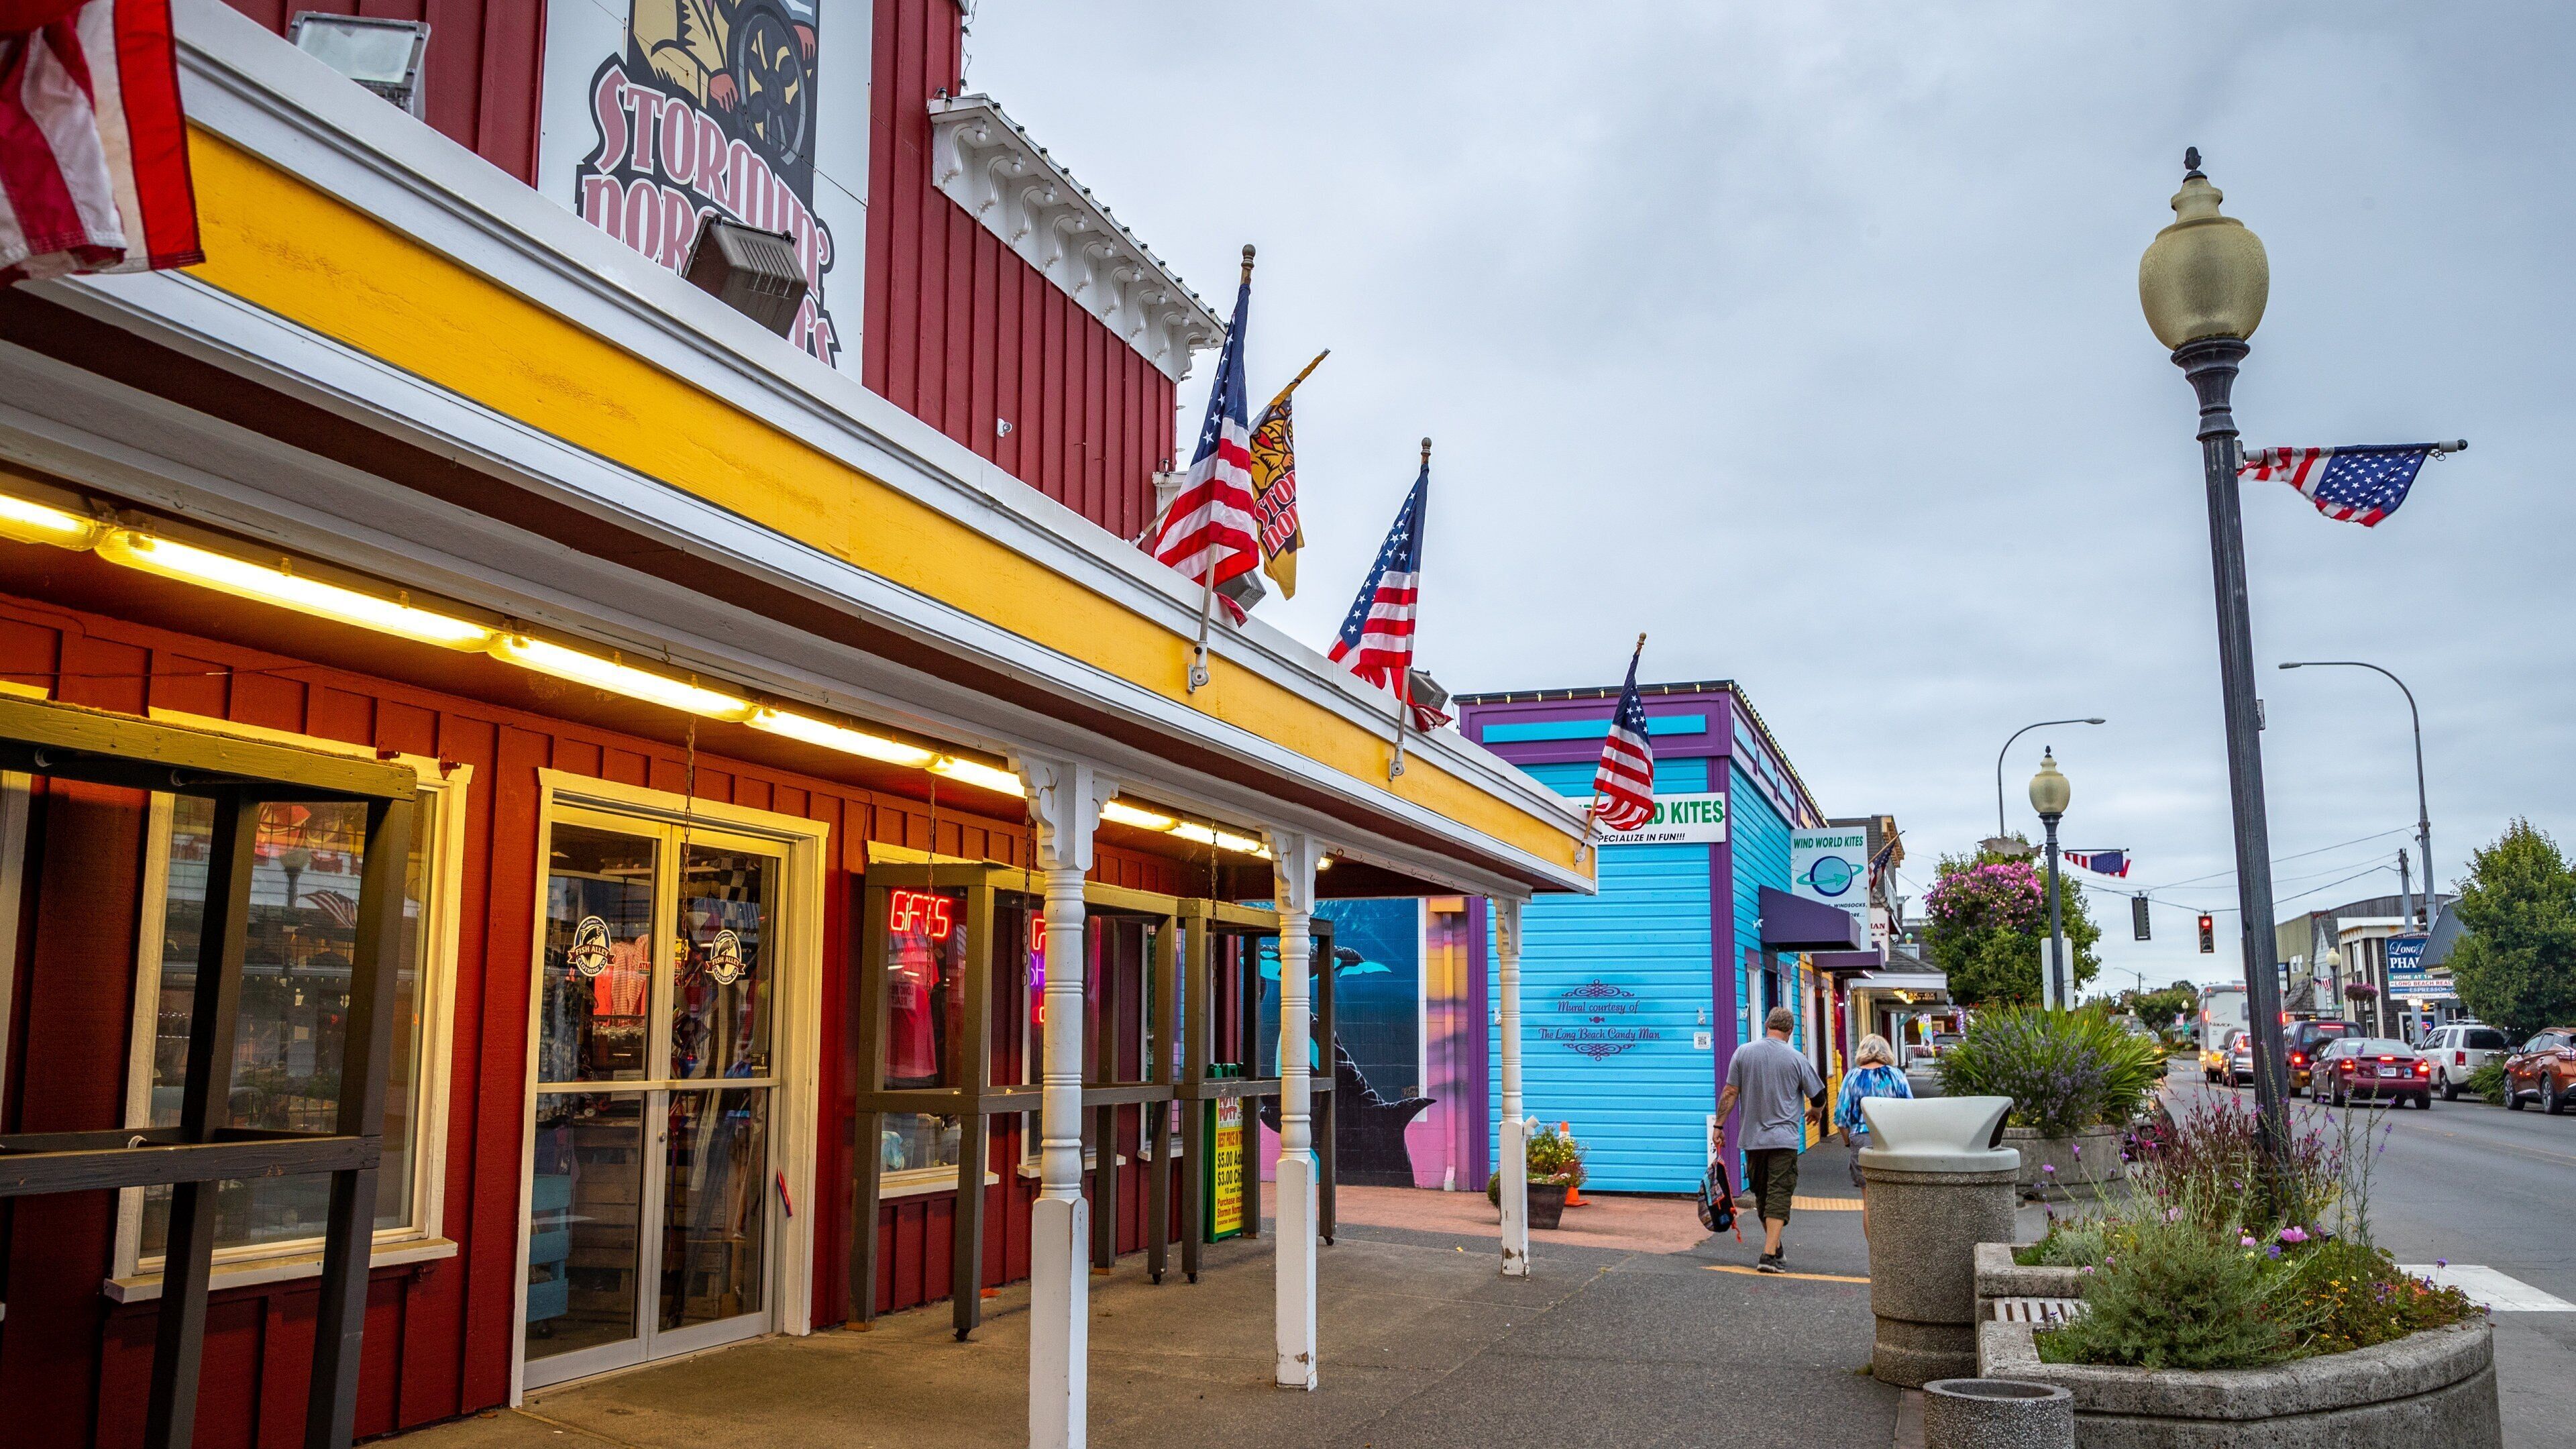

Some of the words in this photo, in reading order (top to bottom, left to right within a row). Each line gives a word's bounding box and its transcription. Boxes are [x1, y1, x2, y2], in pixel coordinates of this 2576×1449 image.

[1670, 800, 1723, 824] KITES
[1597, 834, 1644, 843] PECIALIZE
[1646, 833, 1656, 841] IN
[1659, 833, 1685, 841] FUN!!!
[1793, 838, 1813, 849] WIND
[1815, 837, 1843, 849] WORLD
[1844, 836, 1864, 847] KITES
[576, 946, 590, 956] FISH
[591, 945, 609, 957] ALLEY
[578, 957, 599, 973] CLOTHING
[712, 957, 724, 965] FISH
[725, 957, 740, 966] ALLEY
[713, 967, 732, 982] CLOTHING
[1557, 1000, 1586, 1012] Mural
[1589, 1002, 1626, 1014] courtesy
[1629, 1000, 1640, 1014] of
[1538, 1028, 1554, 1039] The
[1555, 1028, 1576, 1040] Long
[1578, 1028, 1605, 1039] Beach
[1607, 1028, 1636, 1041] Candy
[1638, 1027, 1661, 1039] Man
[1218, 1132, 1226, 1148] BEST
[1226, 1130, 1235, 1147] PRICE
[1218, 1150, 1233, 1169] $5.00
[1218, 1169, 1233, 1187] $3.00
[1218, 1197, 1235, 1207] Purchase
